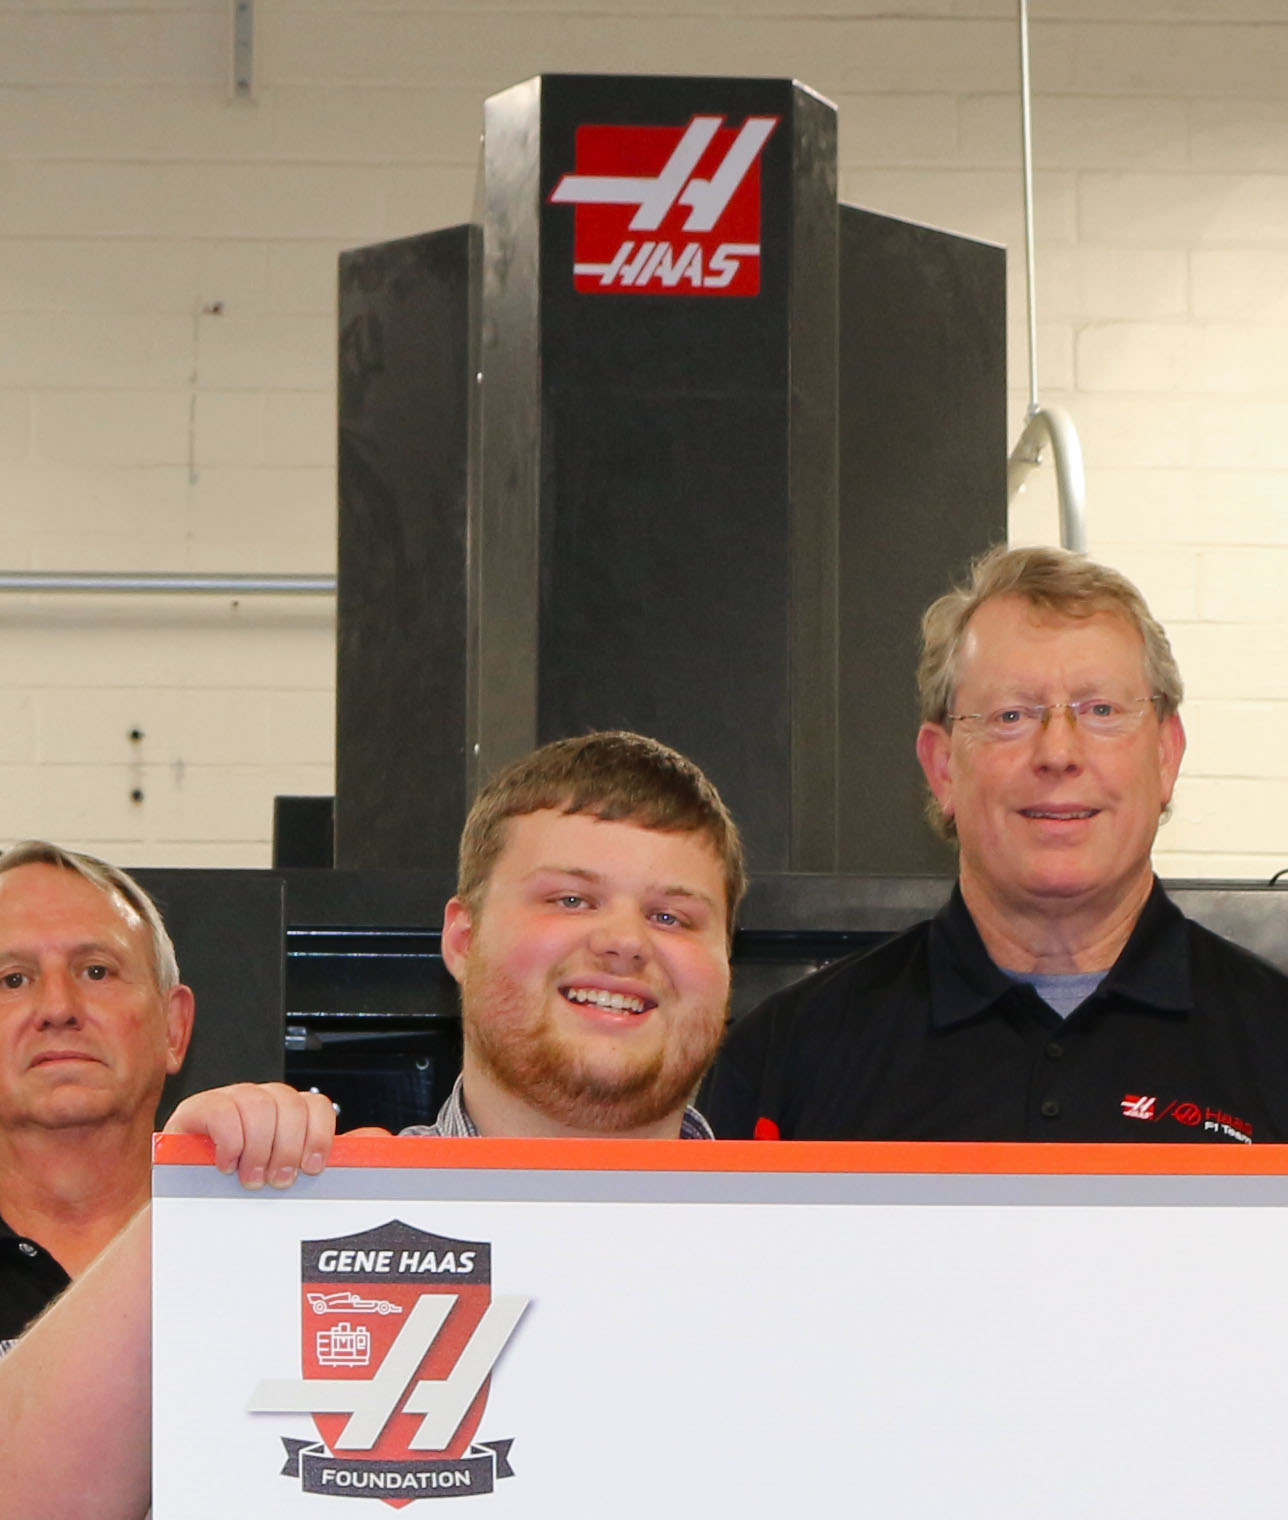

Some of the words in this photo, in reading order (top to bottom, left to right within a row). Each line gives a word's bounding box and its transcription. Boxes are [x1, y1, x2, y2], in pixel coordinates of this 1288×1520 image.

[573, 241, 761, 288] HAAS
[317, 1250, 393, 1274] GENE
[398, 1251, 476, 1274] HAAS
[320, 1468, 472, 1490] FOUNDATION
